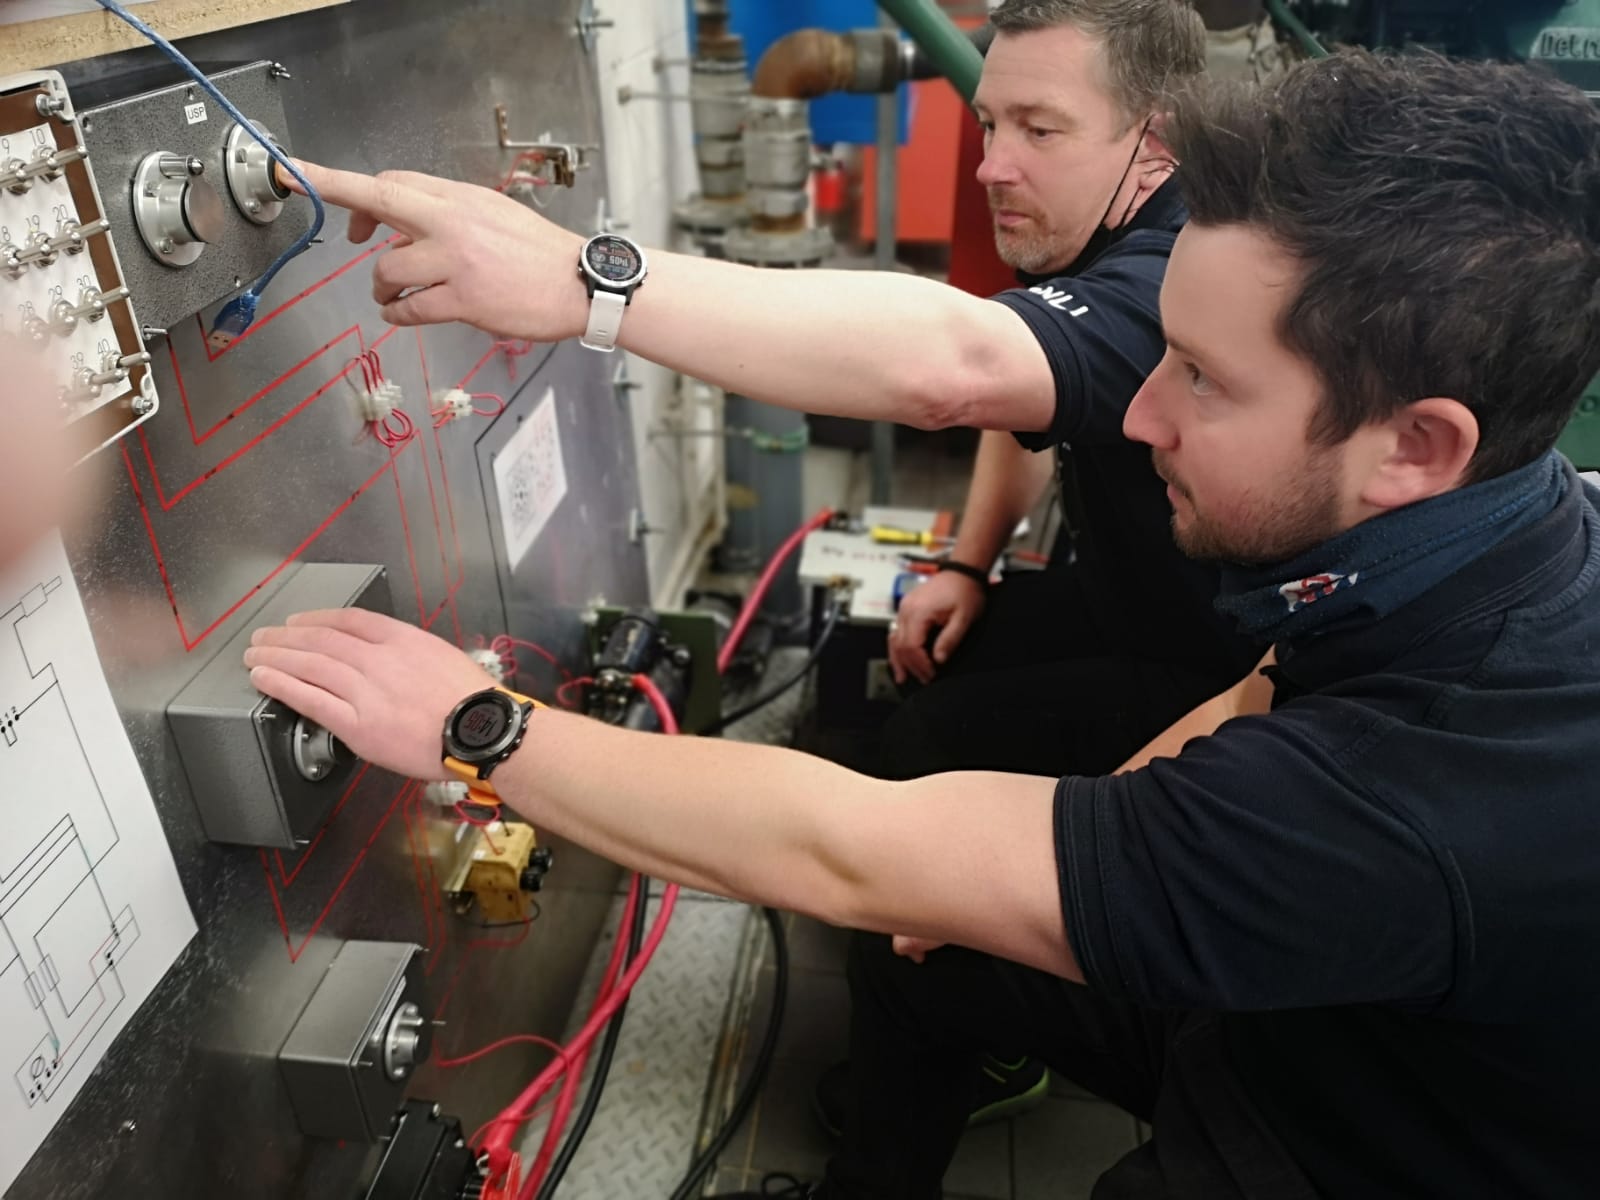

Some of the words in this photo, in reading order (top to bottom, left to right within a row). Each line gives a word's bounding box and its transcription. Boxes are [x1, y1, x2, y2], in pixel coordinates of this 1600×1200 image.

[188, 106, 204, 120] USP
[29, 128, 46, 147] 10
[25, 214, 40, 234] 19
[52, 204, 69, 223] 20
[70, 351, 84, 370] 39
[97, 338, 111, 355] 40
